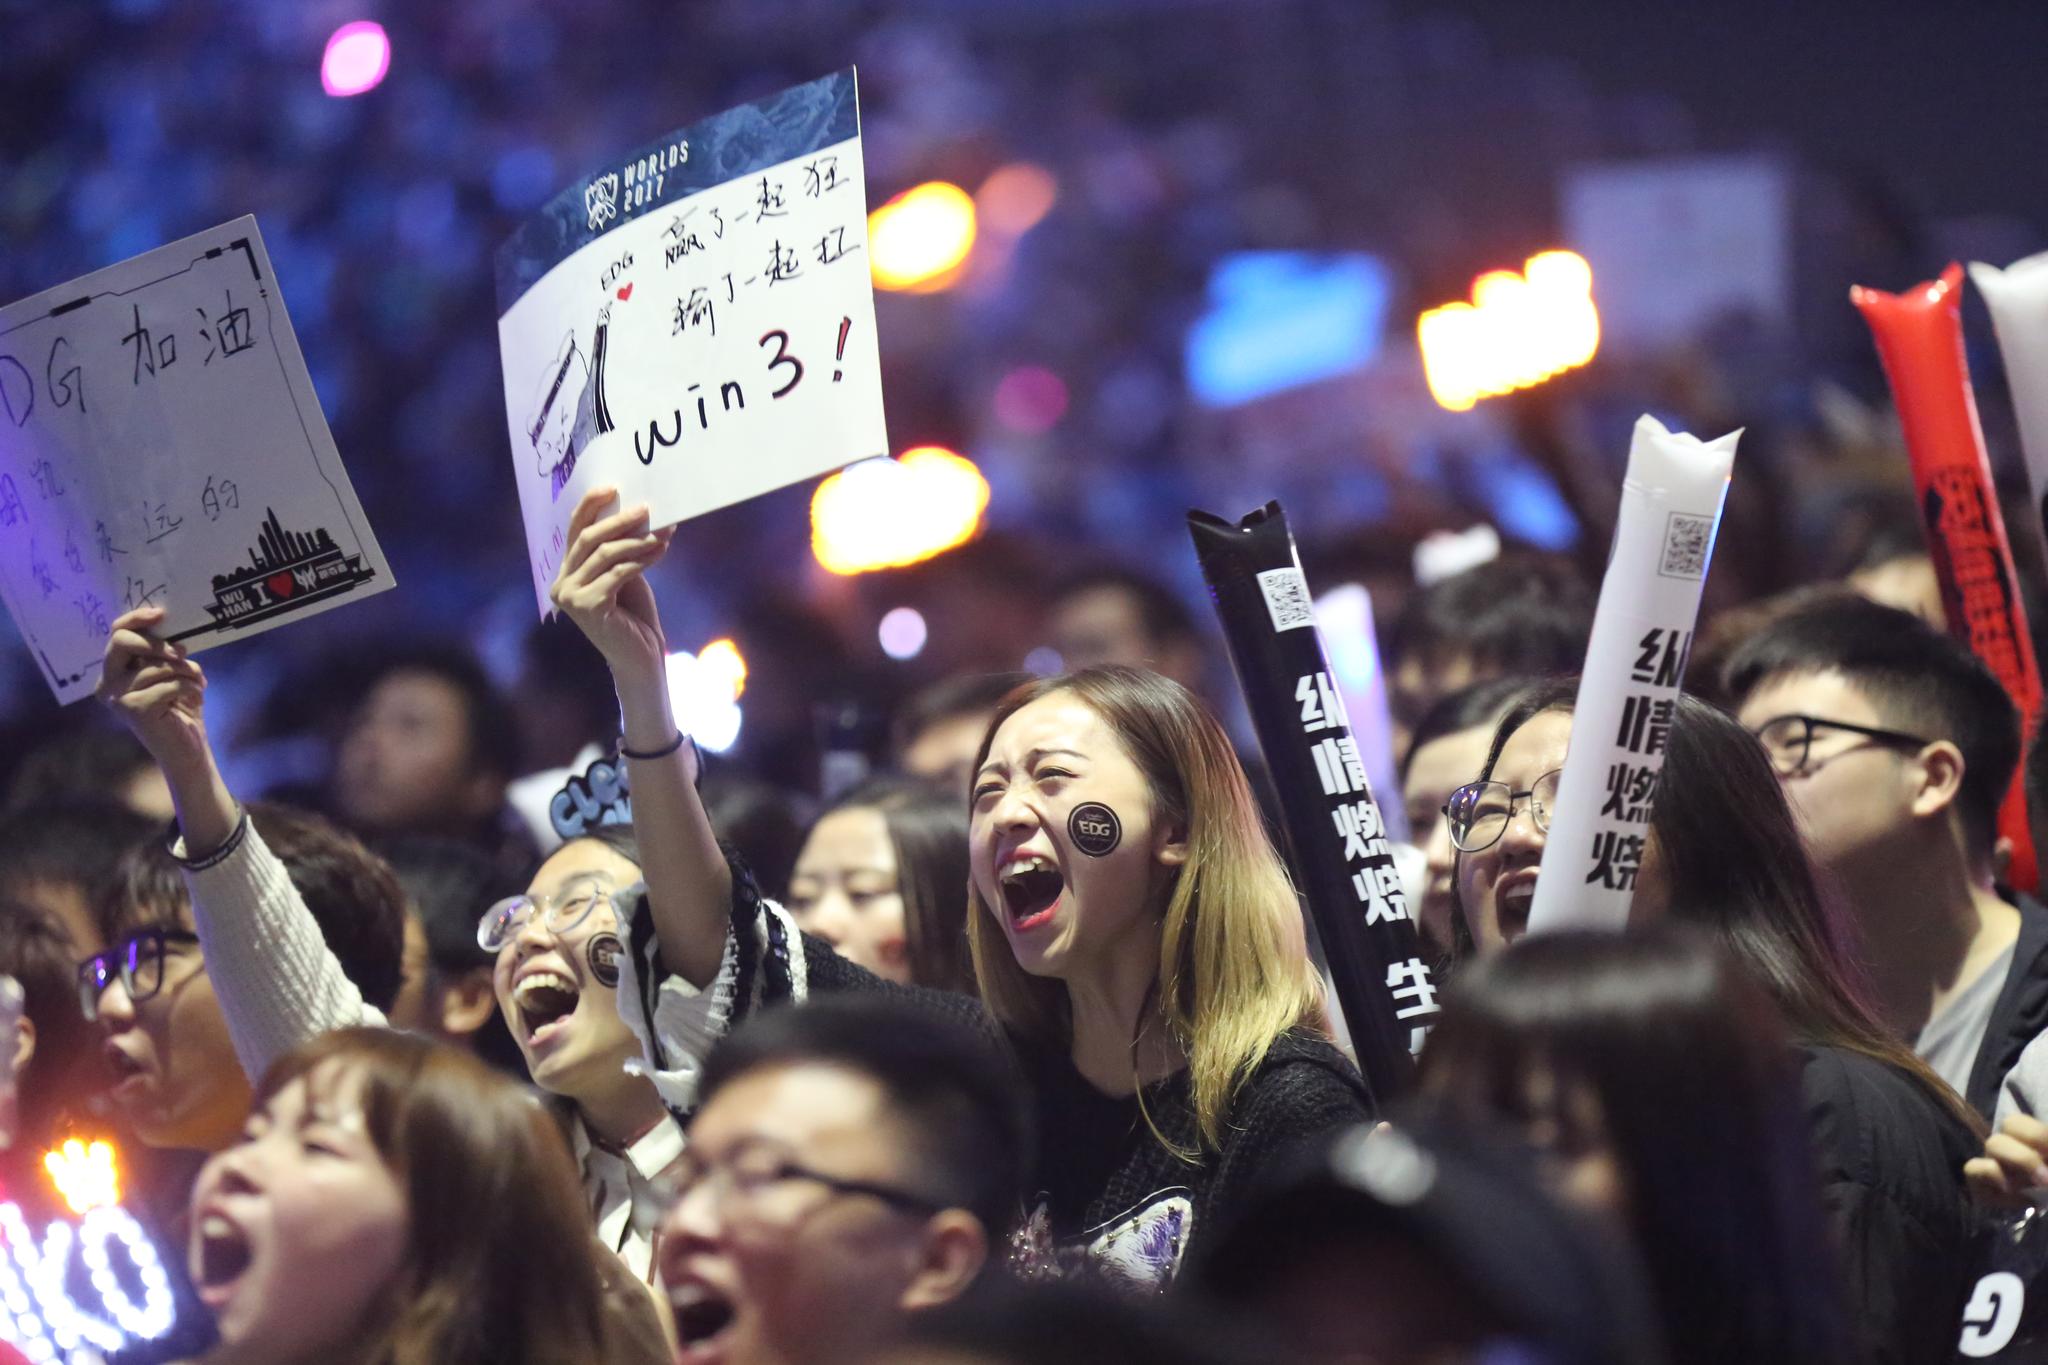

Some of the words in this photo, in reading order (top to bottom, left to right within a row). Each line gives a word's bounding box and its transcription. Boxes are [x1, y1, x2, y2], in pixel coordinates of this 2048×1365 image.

[624, 139, 689, 189] WORLDS
[624, 174, 664, 212] 2017
[601, 250, 634, 291] EDG
[121, 290, 257, 385] 加油
[220, 589, 245, 606] WU
[222, 600, 254, 619] HAN
[1078, 820, 1111, 837] EDG
